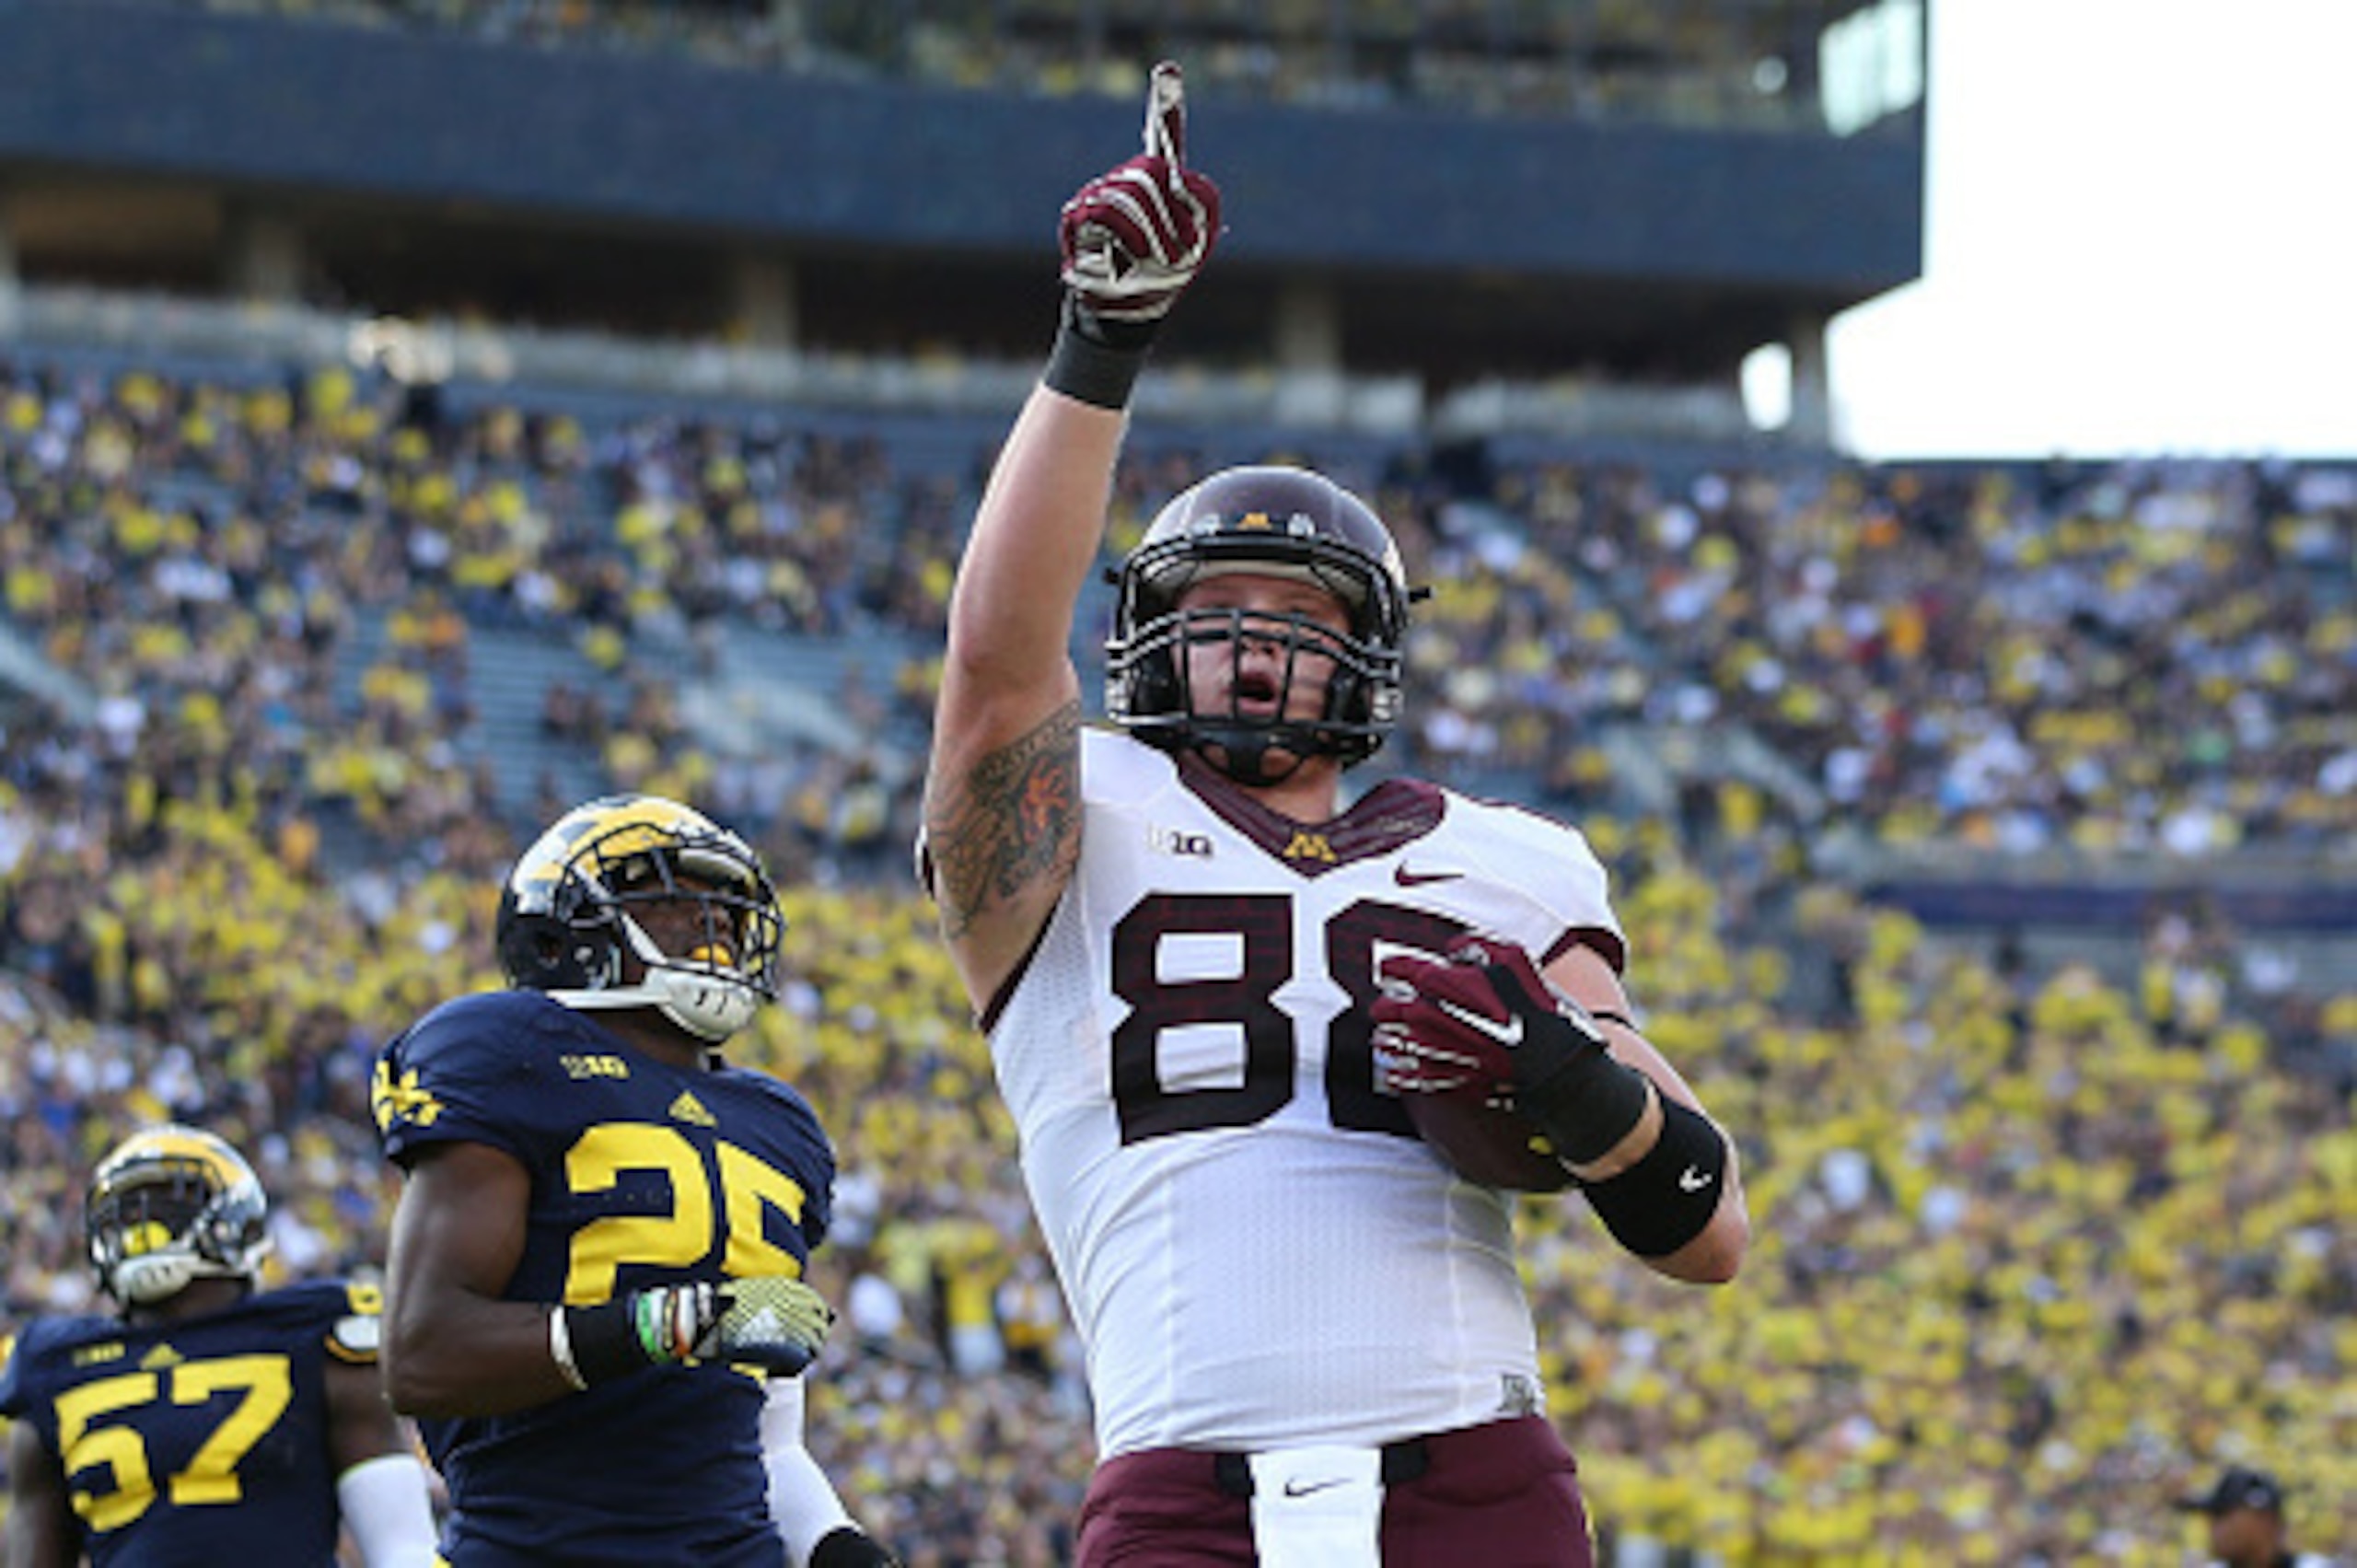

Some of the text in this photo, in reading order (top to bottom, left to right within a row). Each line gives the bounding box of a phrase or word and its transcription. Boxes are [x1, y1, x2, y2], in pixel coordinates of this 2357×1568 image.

[1283, 831, 1338, 862] M
[563, 1121, 808, 1383] 25
[52, 1353, 295, 1534] 57
